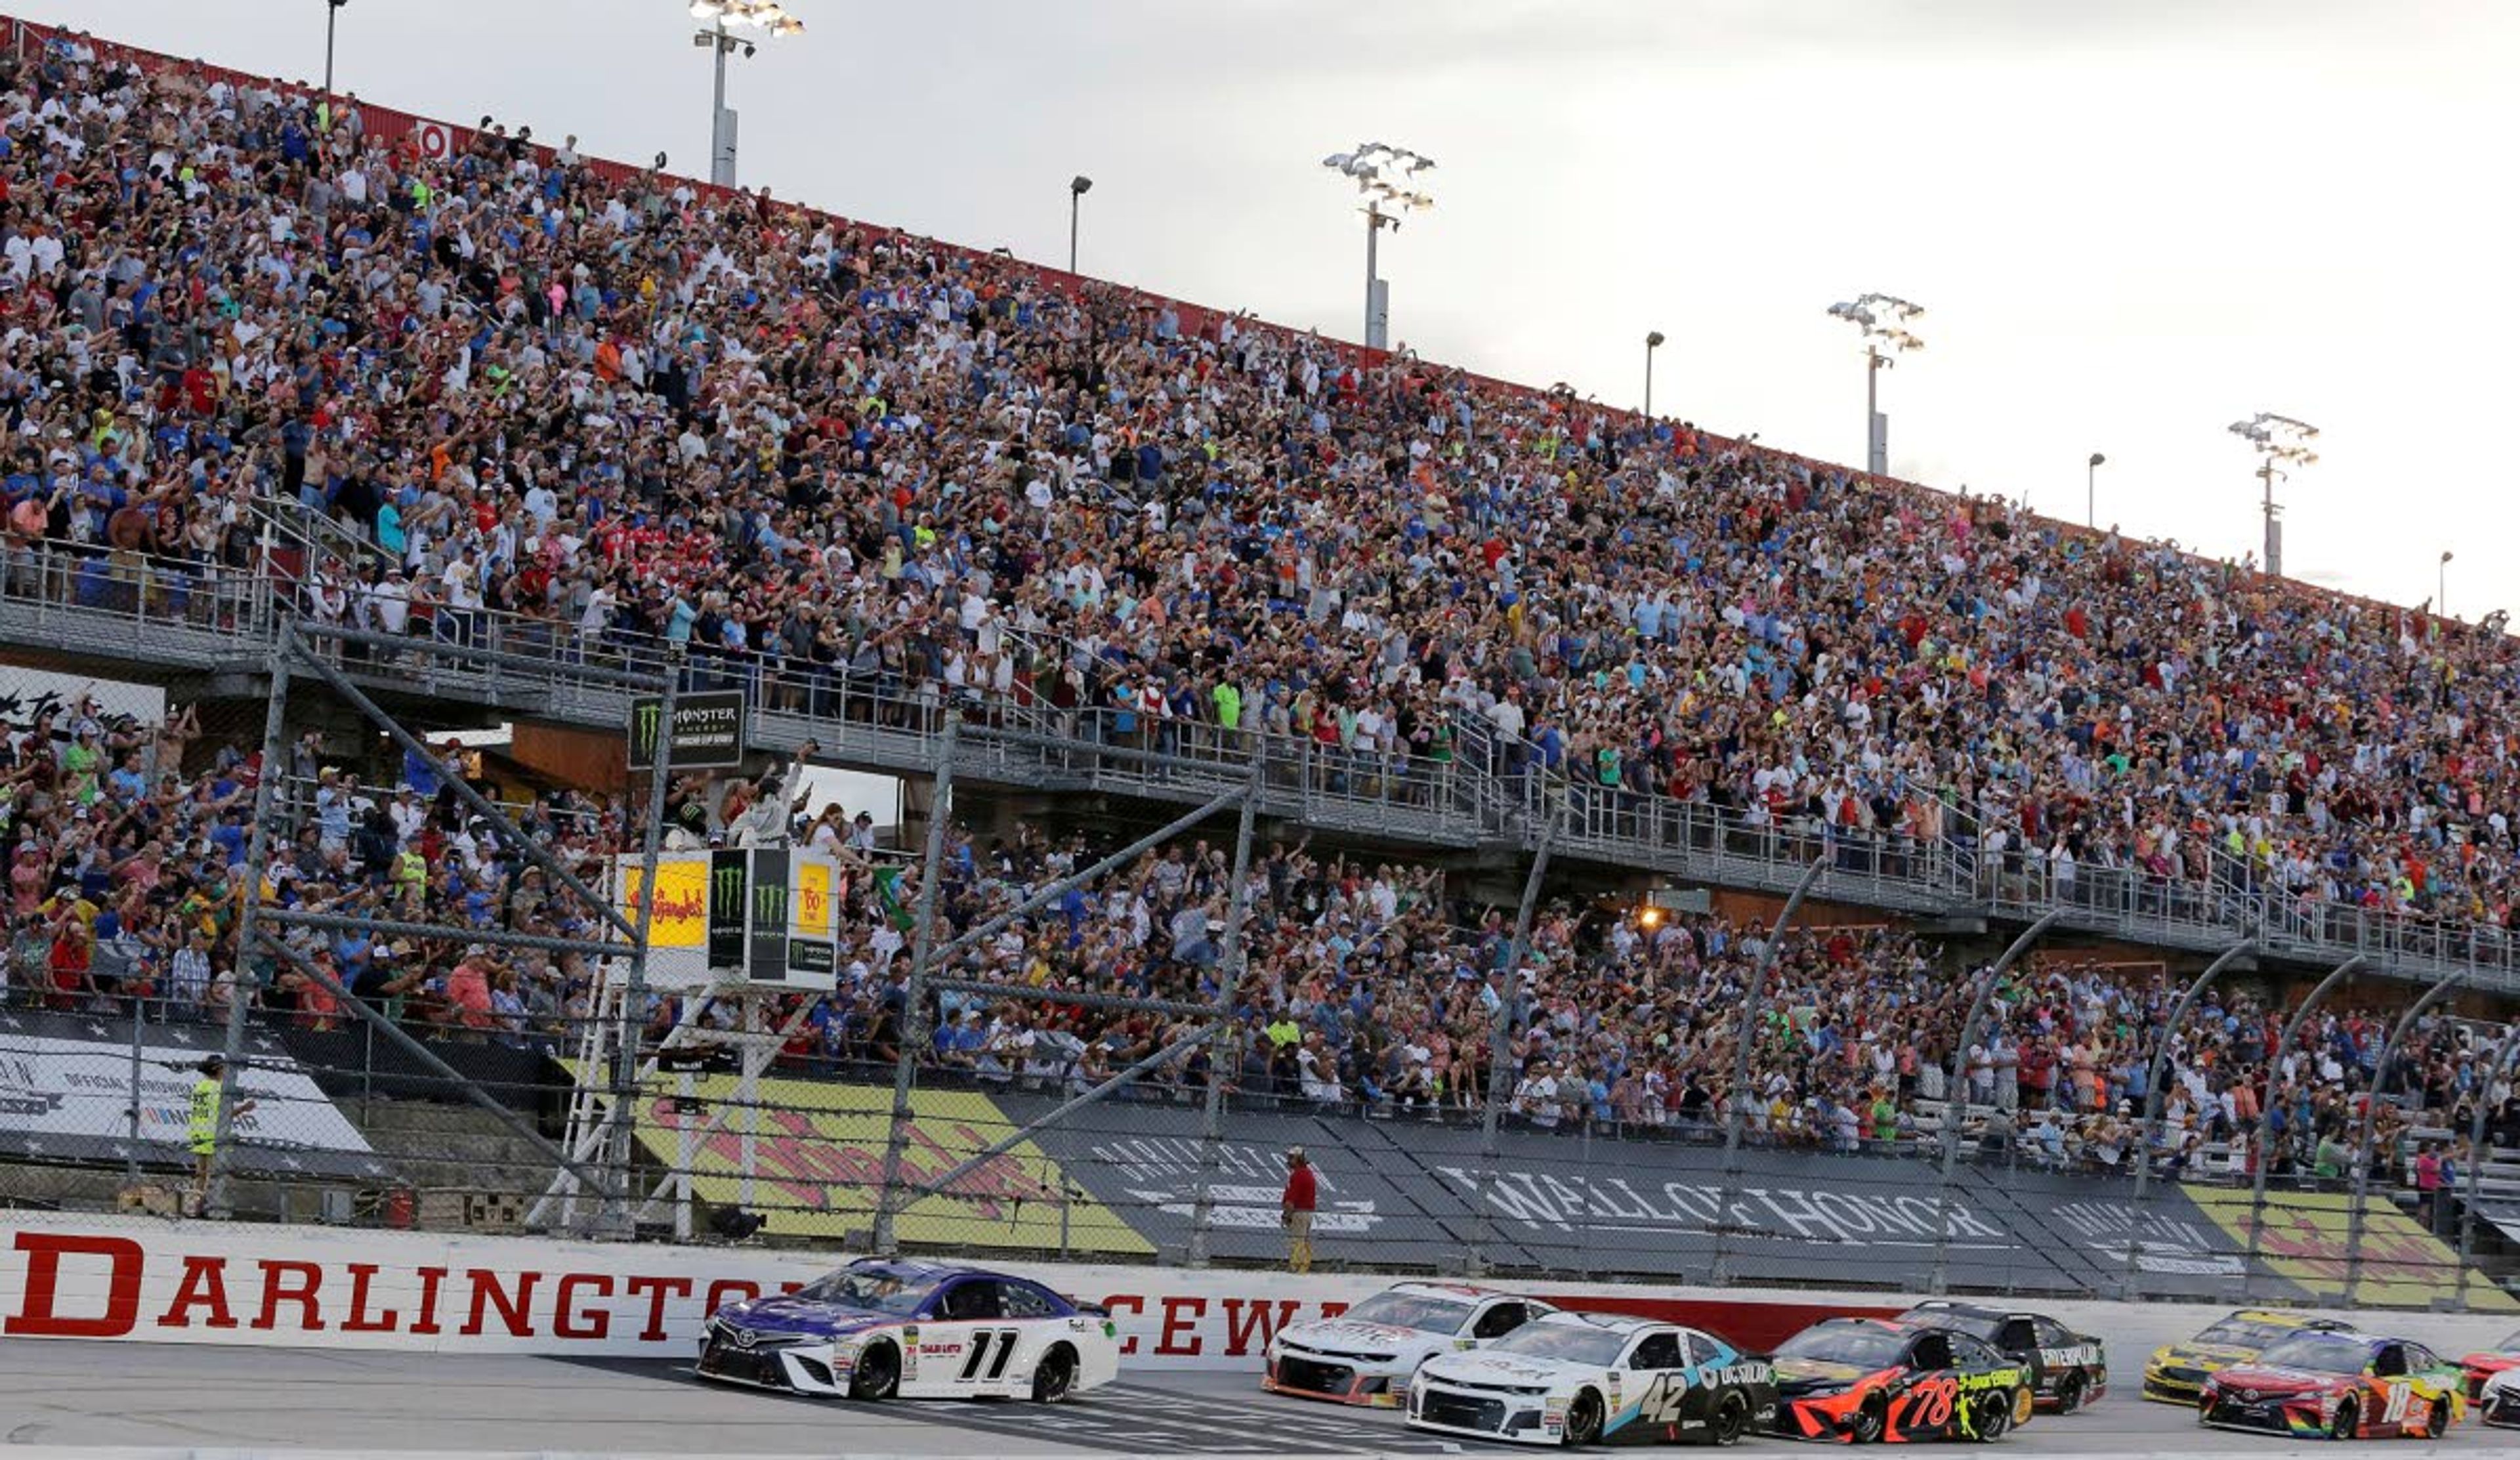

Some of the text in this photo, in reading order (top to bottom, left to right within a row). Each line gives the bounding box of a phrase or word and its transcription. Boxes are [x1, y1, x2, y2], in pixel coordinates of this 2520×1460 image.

[4, 1231, 807, 1342] DARLINGT
[955, 1327, 1022, 1383] 11
[1641, 1371, 1689, 1423] 42
[1910, 1377, 1958, 1427] 78
[2382, 1383, 2411, 1423] 18
